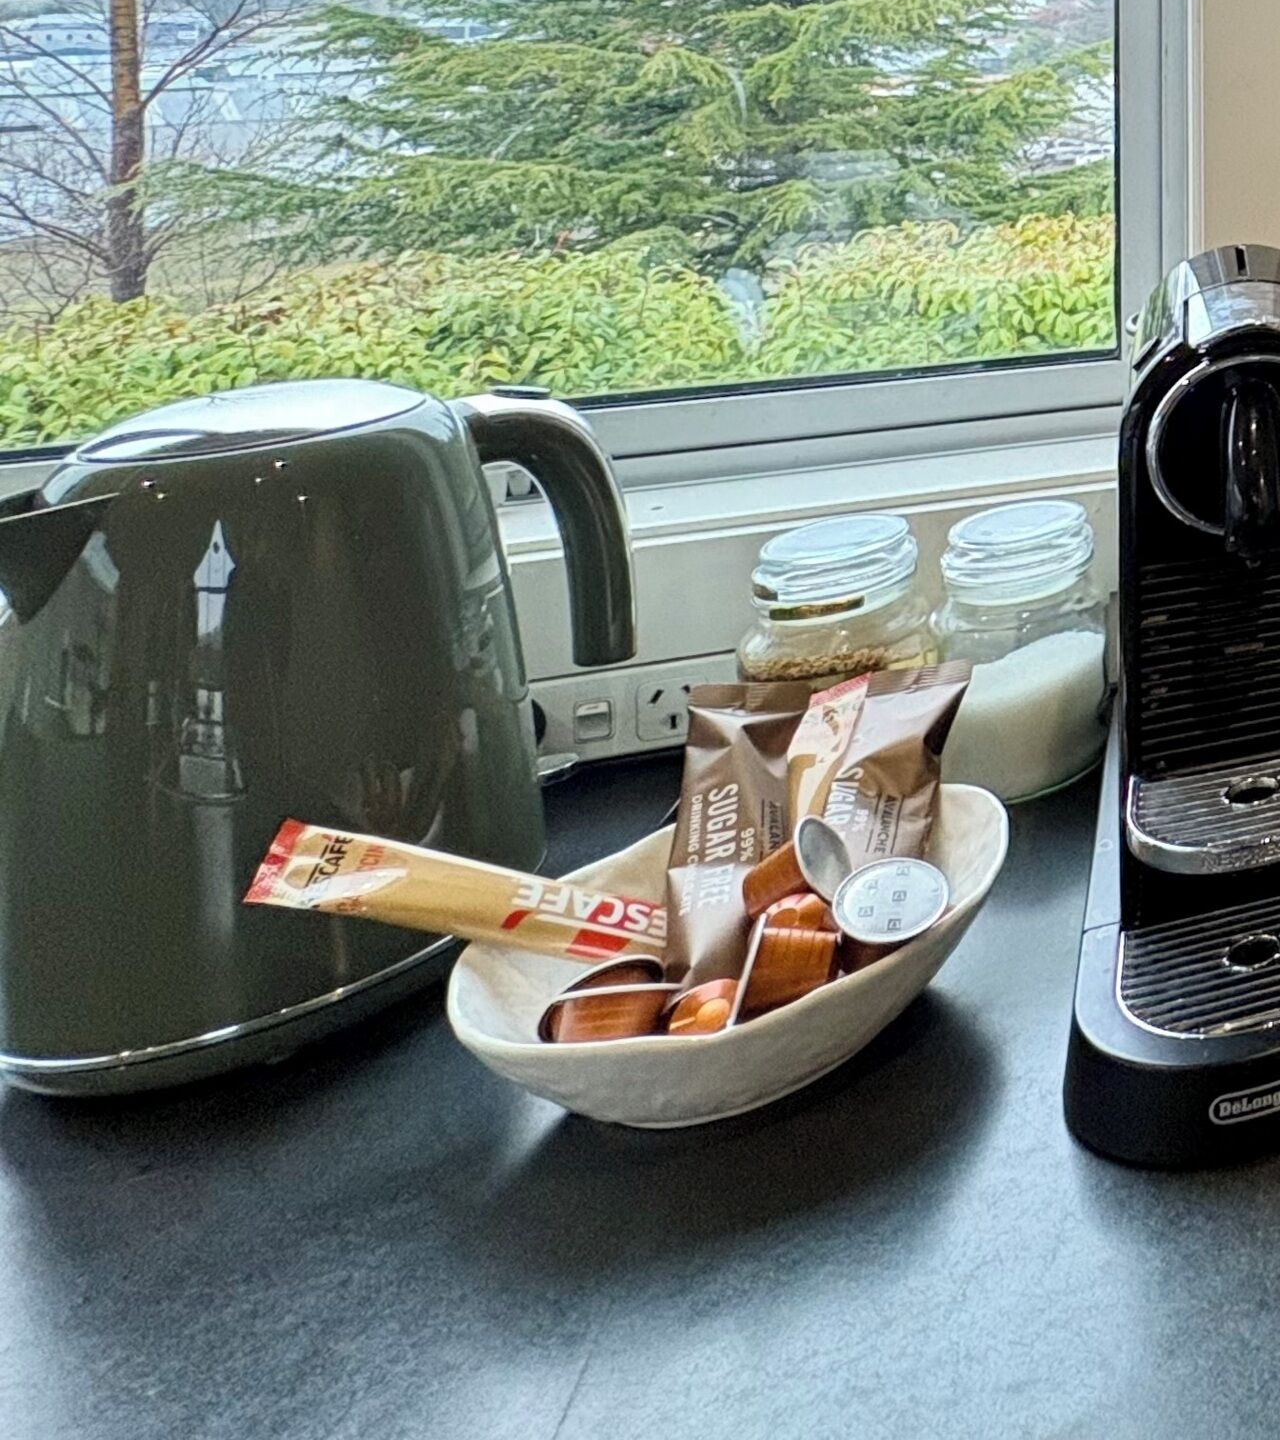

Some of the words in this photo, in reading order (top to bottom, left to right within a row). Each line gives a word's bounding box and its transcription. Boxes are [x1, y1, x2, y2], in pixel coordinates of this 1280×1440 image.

[687, 793, 704, 854] DRINKING
[704, 782, 739, 862] SUGAR
[740, 827, 756, 862] 99%
[874, 794, 897, 854] AVALANCHE
[698, 863, 736, 911] FREE
